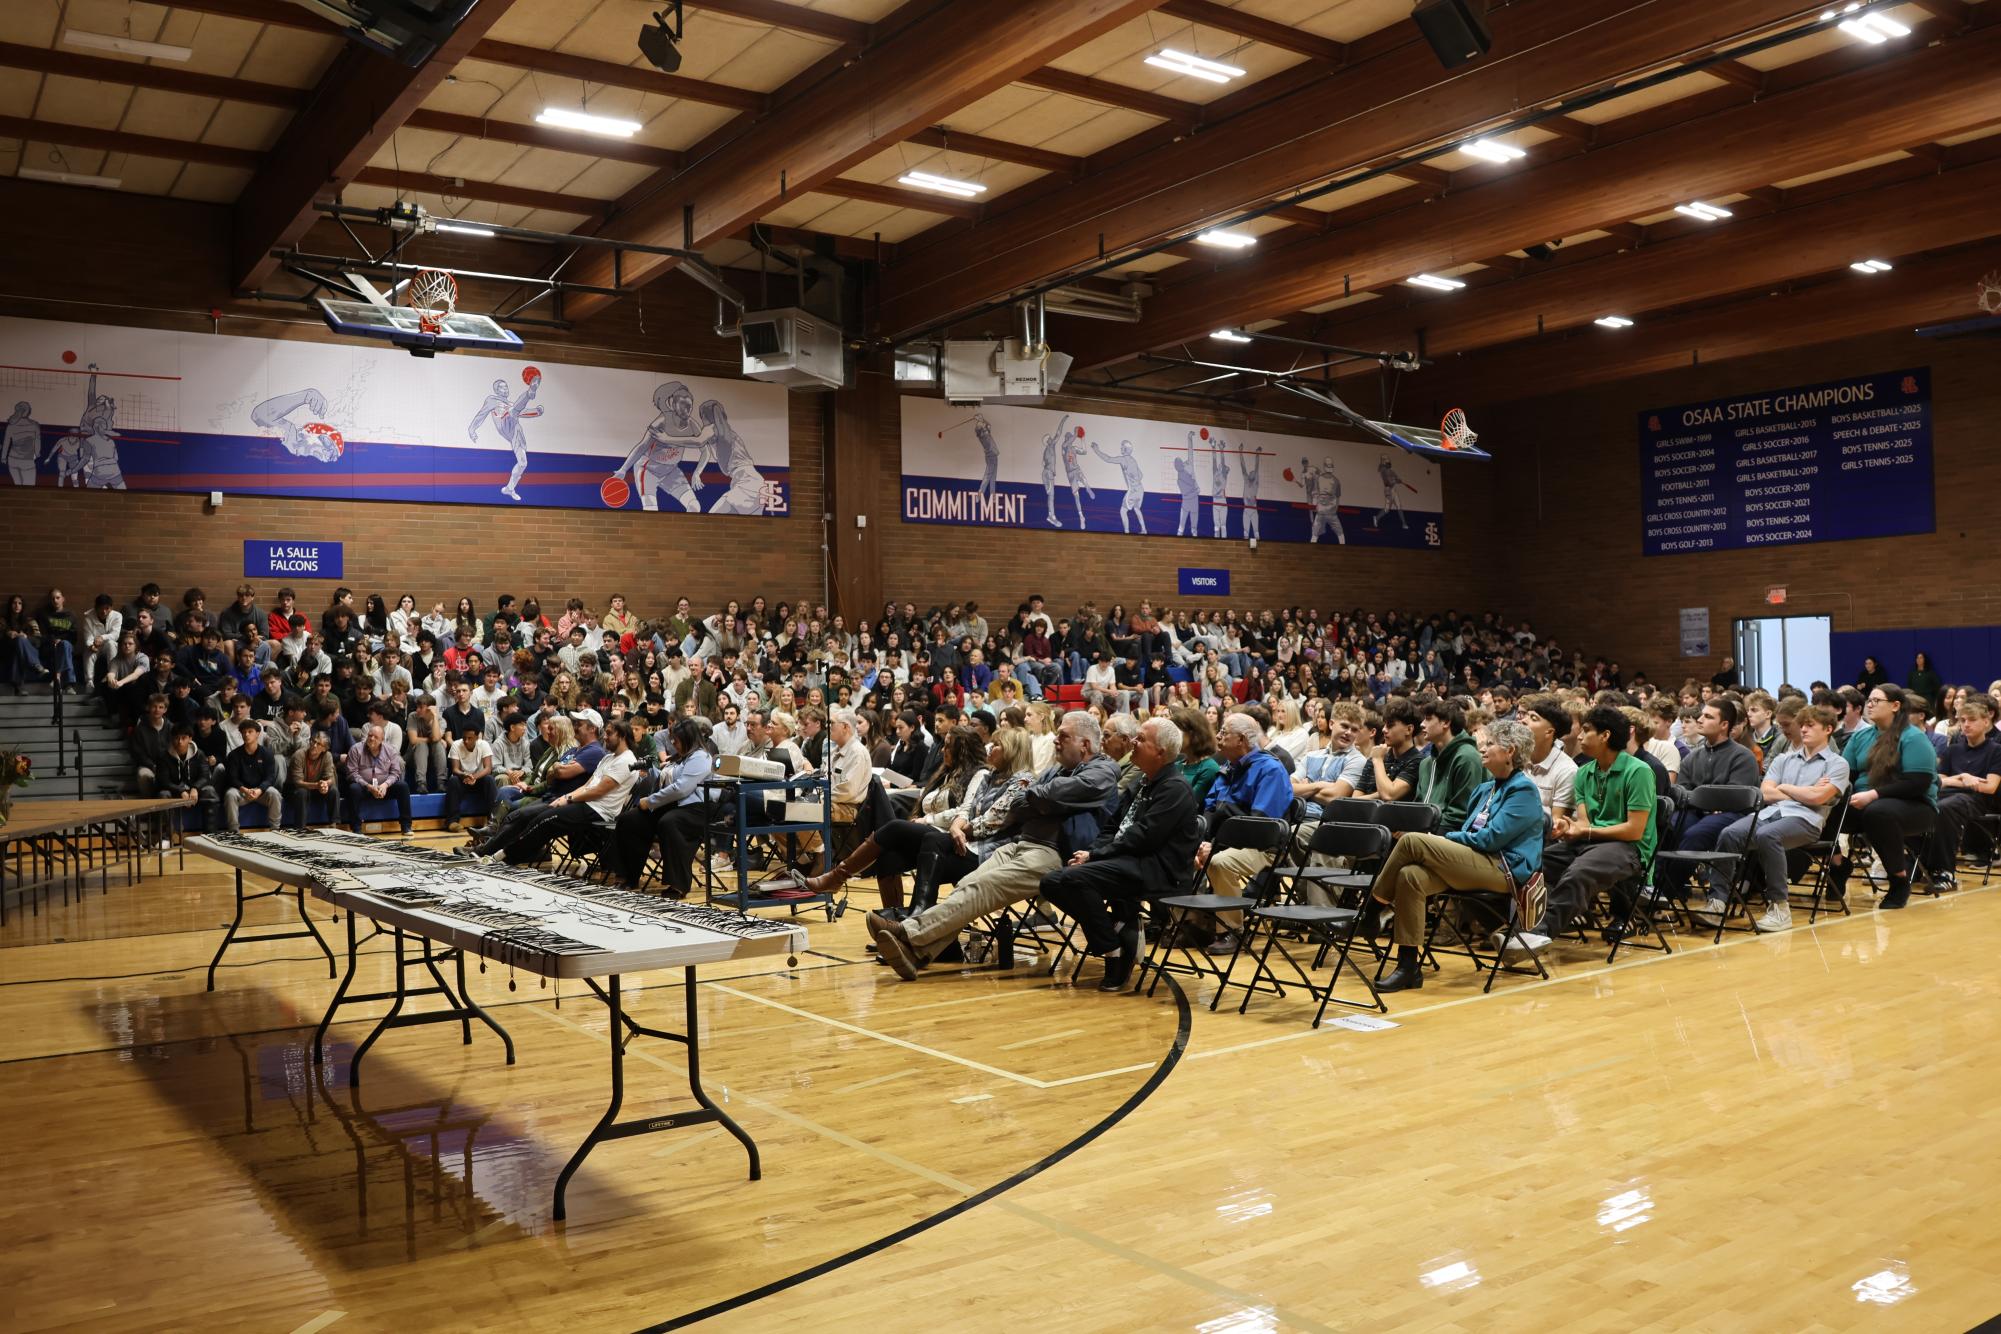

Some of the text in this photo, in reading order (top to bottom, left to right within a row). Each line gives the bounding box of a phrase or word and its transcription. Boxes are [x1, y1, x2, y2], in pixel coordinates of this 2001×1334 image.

[1682, 406, 1723, 426] OSAA
[1727, 399, 1770, 419] STATE
[1775, 383, 1874, 412] CHAMPIONS
[1831, 414, 1851, 423] BOYS
[1735, 428, 1755, 437] GIRLS
[1833, 429, 1860, 439] SPEECH
[1656, 439, 1674, 448] GIRLS
[1742, 442, 1762, 451] GIRLS
[1842, 445, 1861, 454] BOYS
[1654, 454, 1671, 463] BOYS
[1736, 458, 1755, 467] GIRLS
[1842, 460, 1863, 470] GIRLS
[1655, 469, 1671, 477] BOYS
[1736, 474, 1756, 482] GIRLS
[1745, 488, 1763, 496] BOYS
[906, 487, 1027, 524] COMMITMENT
[1658, 498, 1674, 507] BOYS
[1745, 504, 1763, 512] BOYS
[1647, 514, 1663, 522] GIRLS
[1664, 512, 1682, 521] CROSS
[1746, 519, 1764, 527] BOYS
[1664, 527, 1682, 535] CROSS
[1747, 534, 1764, 542] BOYS
[1661, 542, 1677, 550] BOYS
[270, 546, 318, 559] LA SALLE
[270, 560, 318, 571] FALCONS
[1191, 577, 1217, 586] VISITORS
